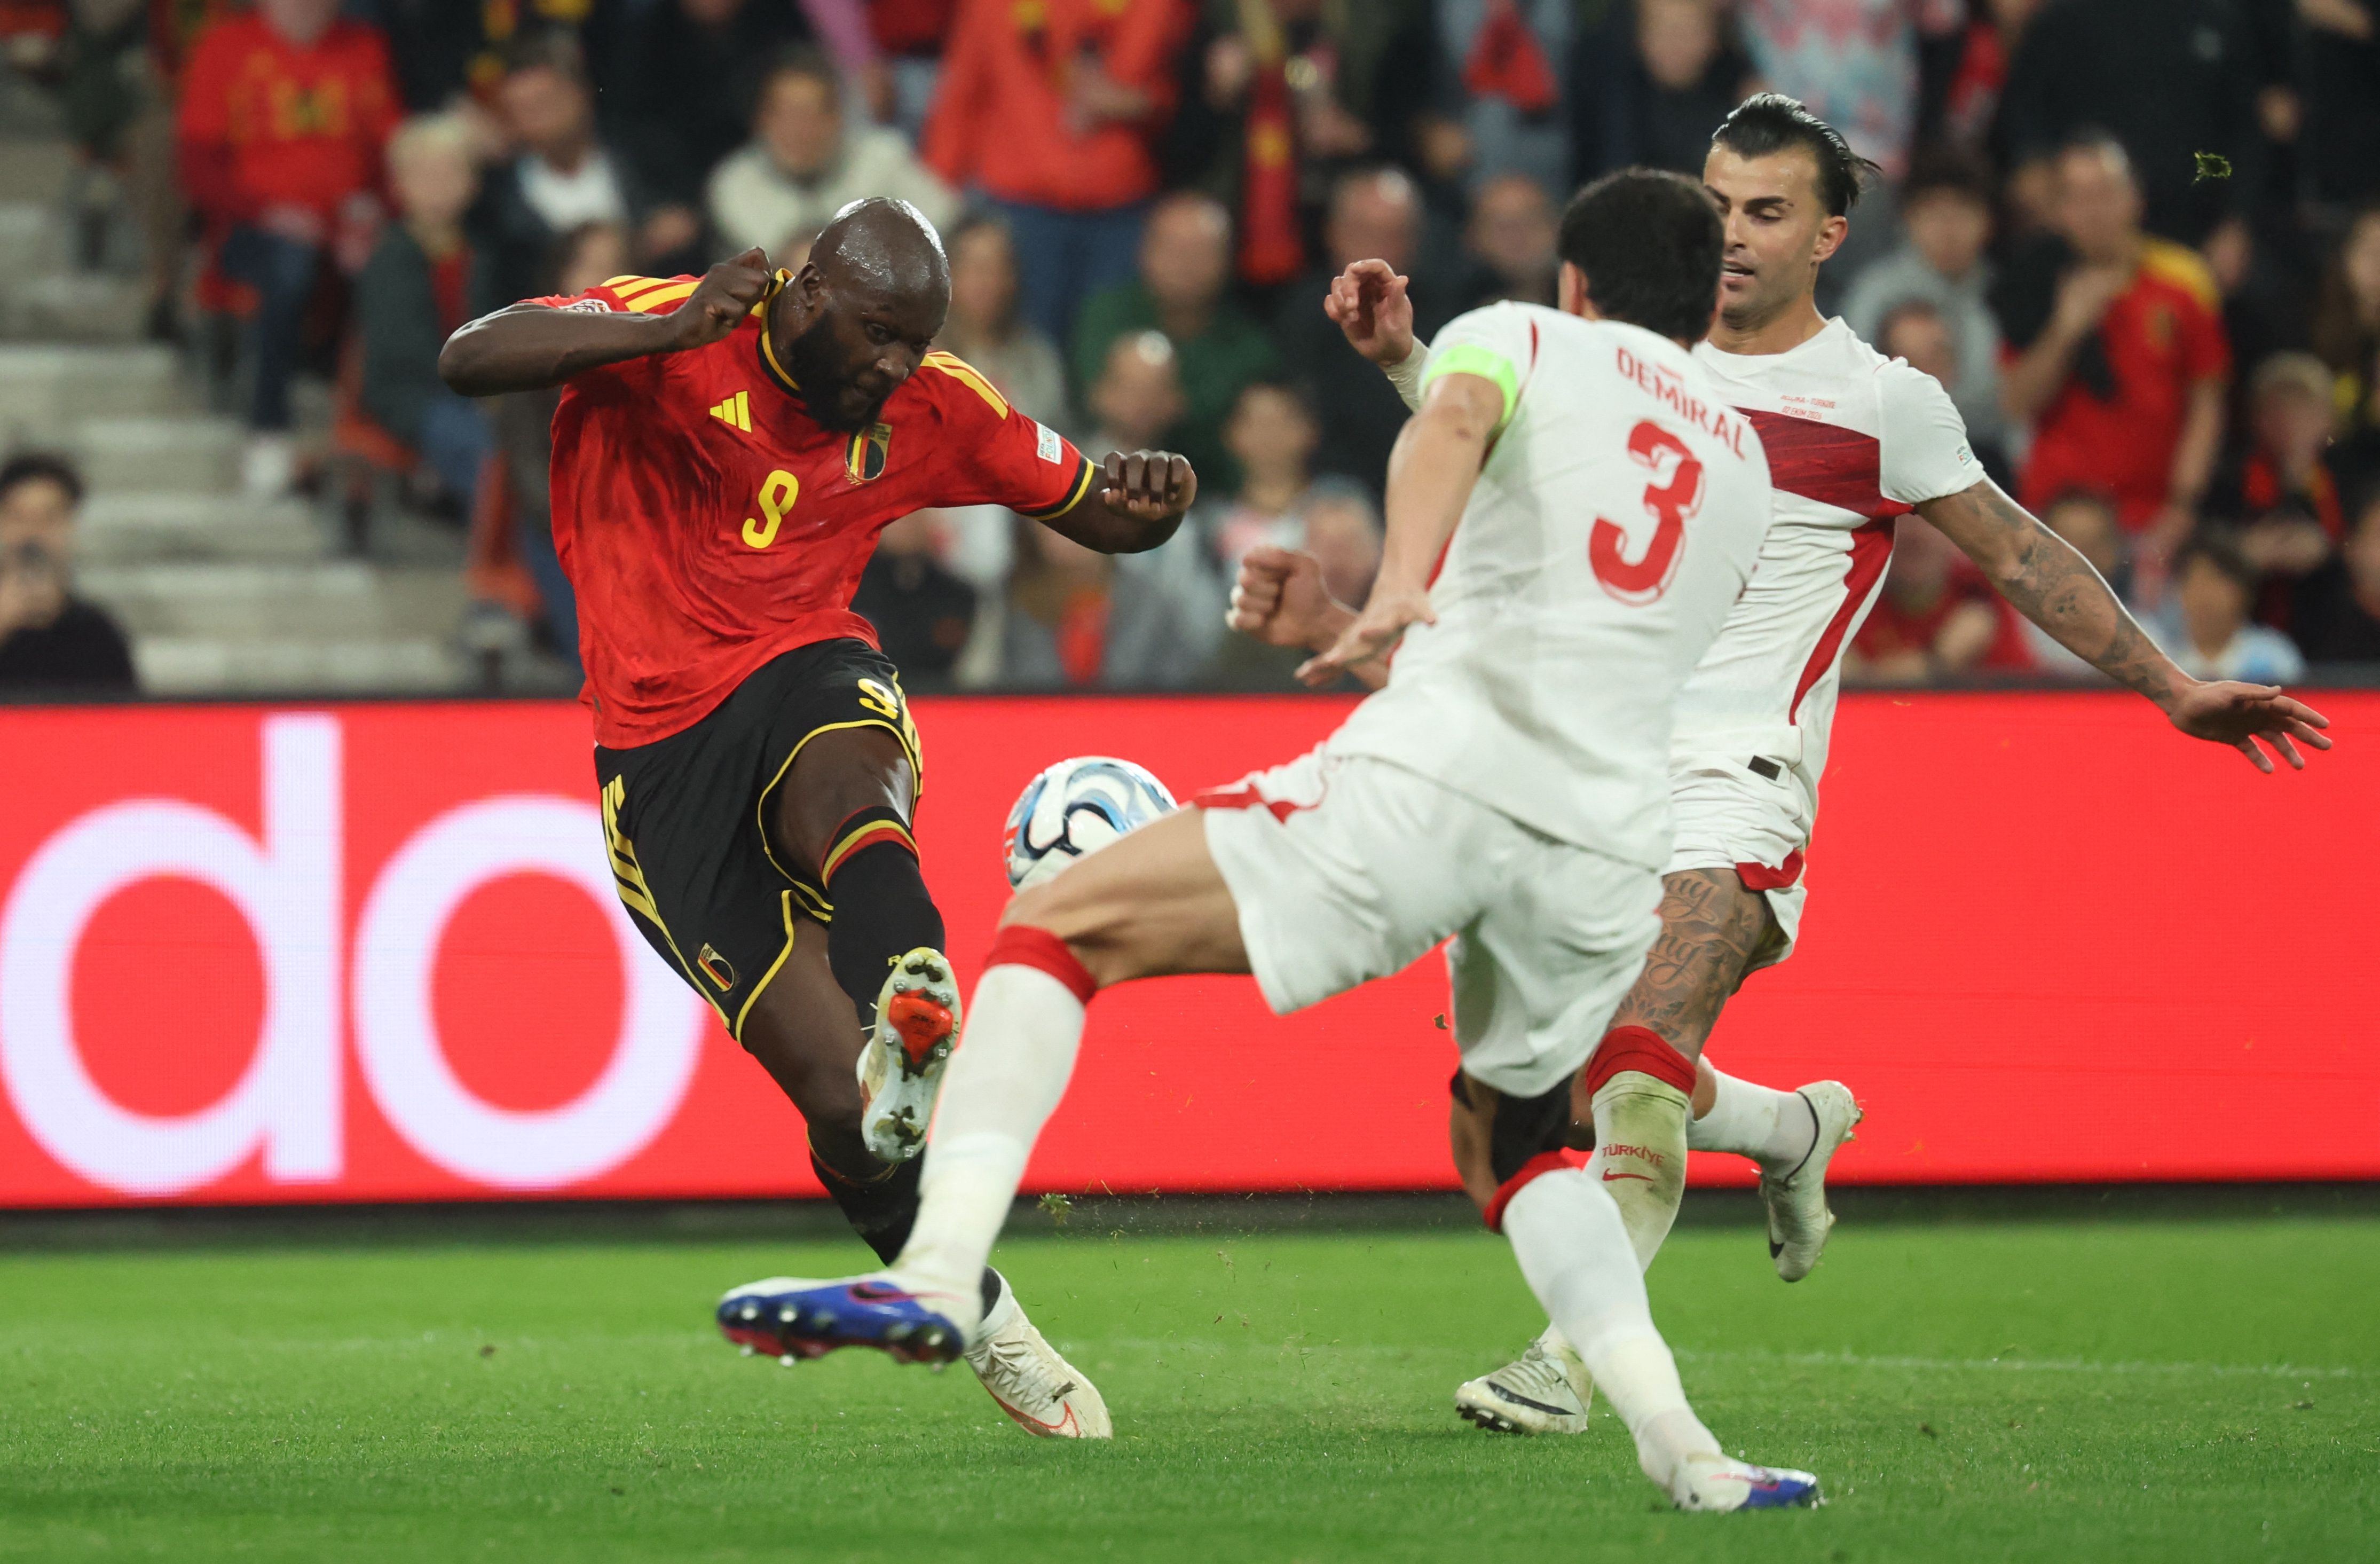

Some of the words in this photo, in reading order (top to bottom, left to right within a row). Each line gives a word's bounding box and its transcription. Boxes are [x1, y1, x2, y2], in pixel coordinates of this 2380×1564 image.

[742, 469, 799, 549] 9
[1589, 420, 1705, 607] 3
[857, 678, 899, 720] 9
